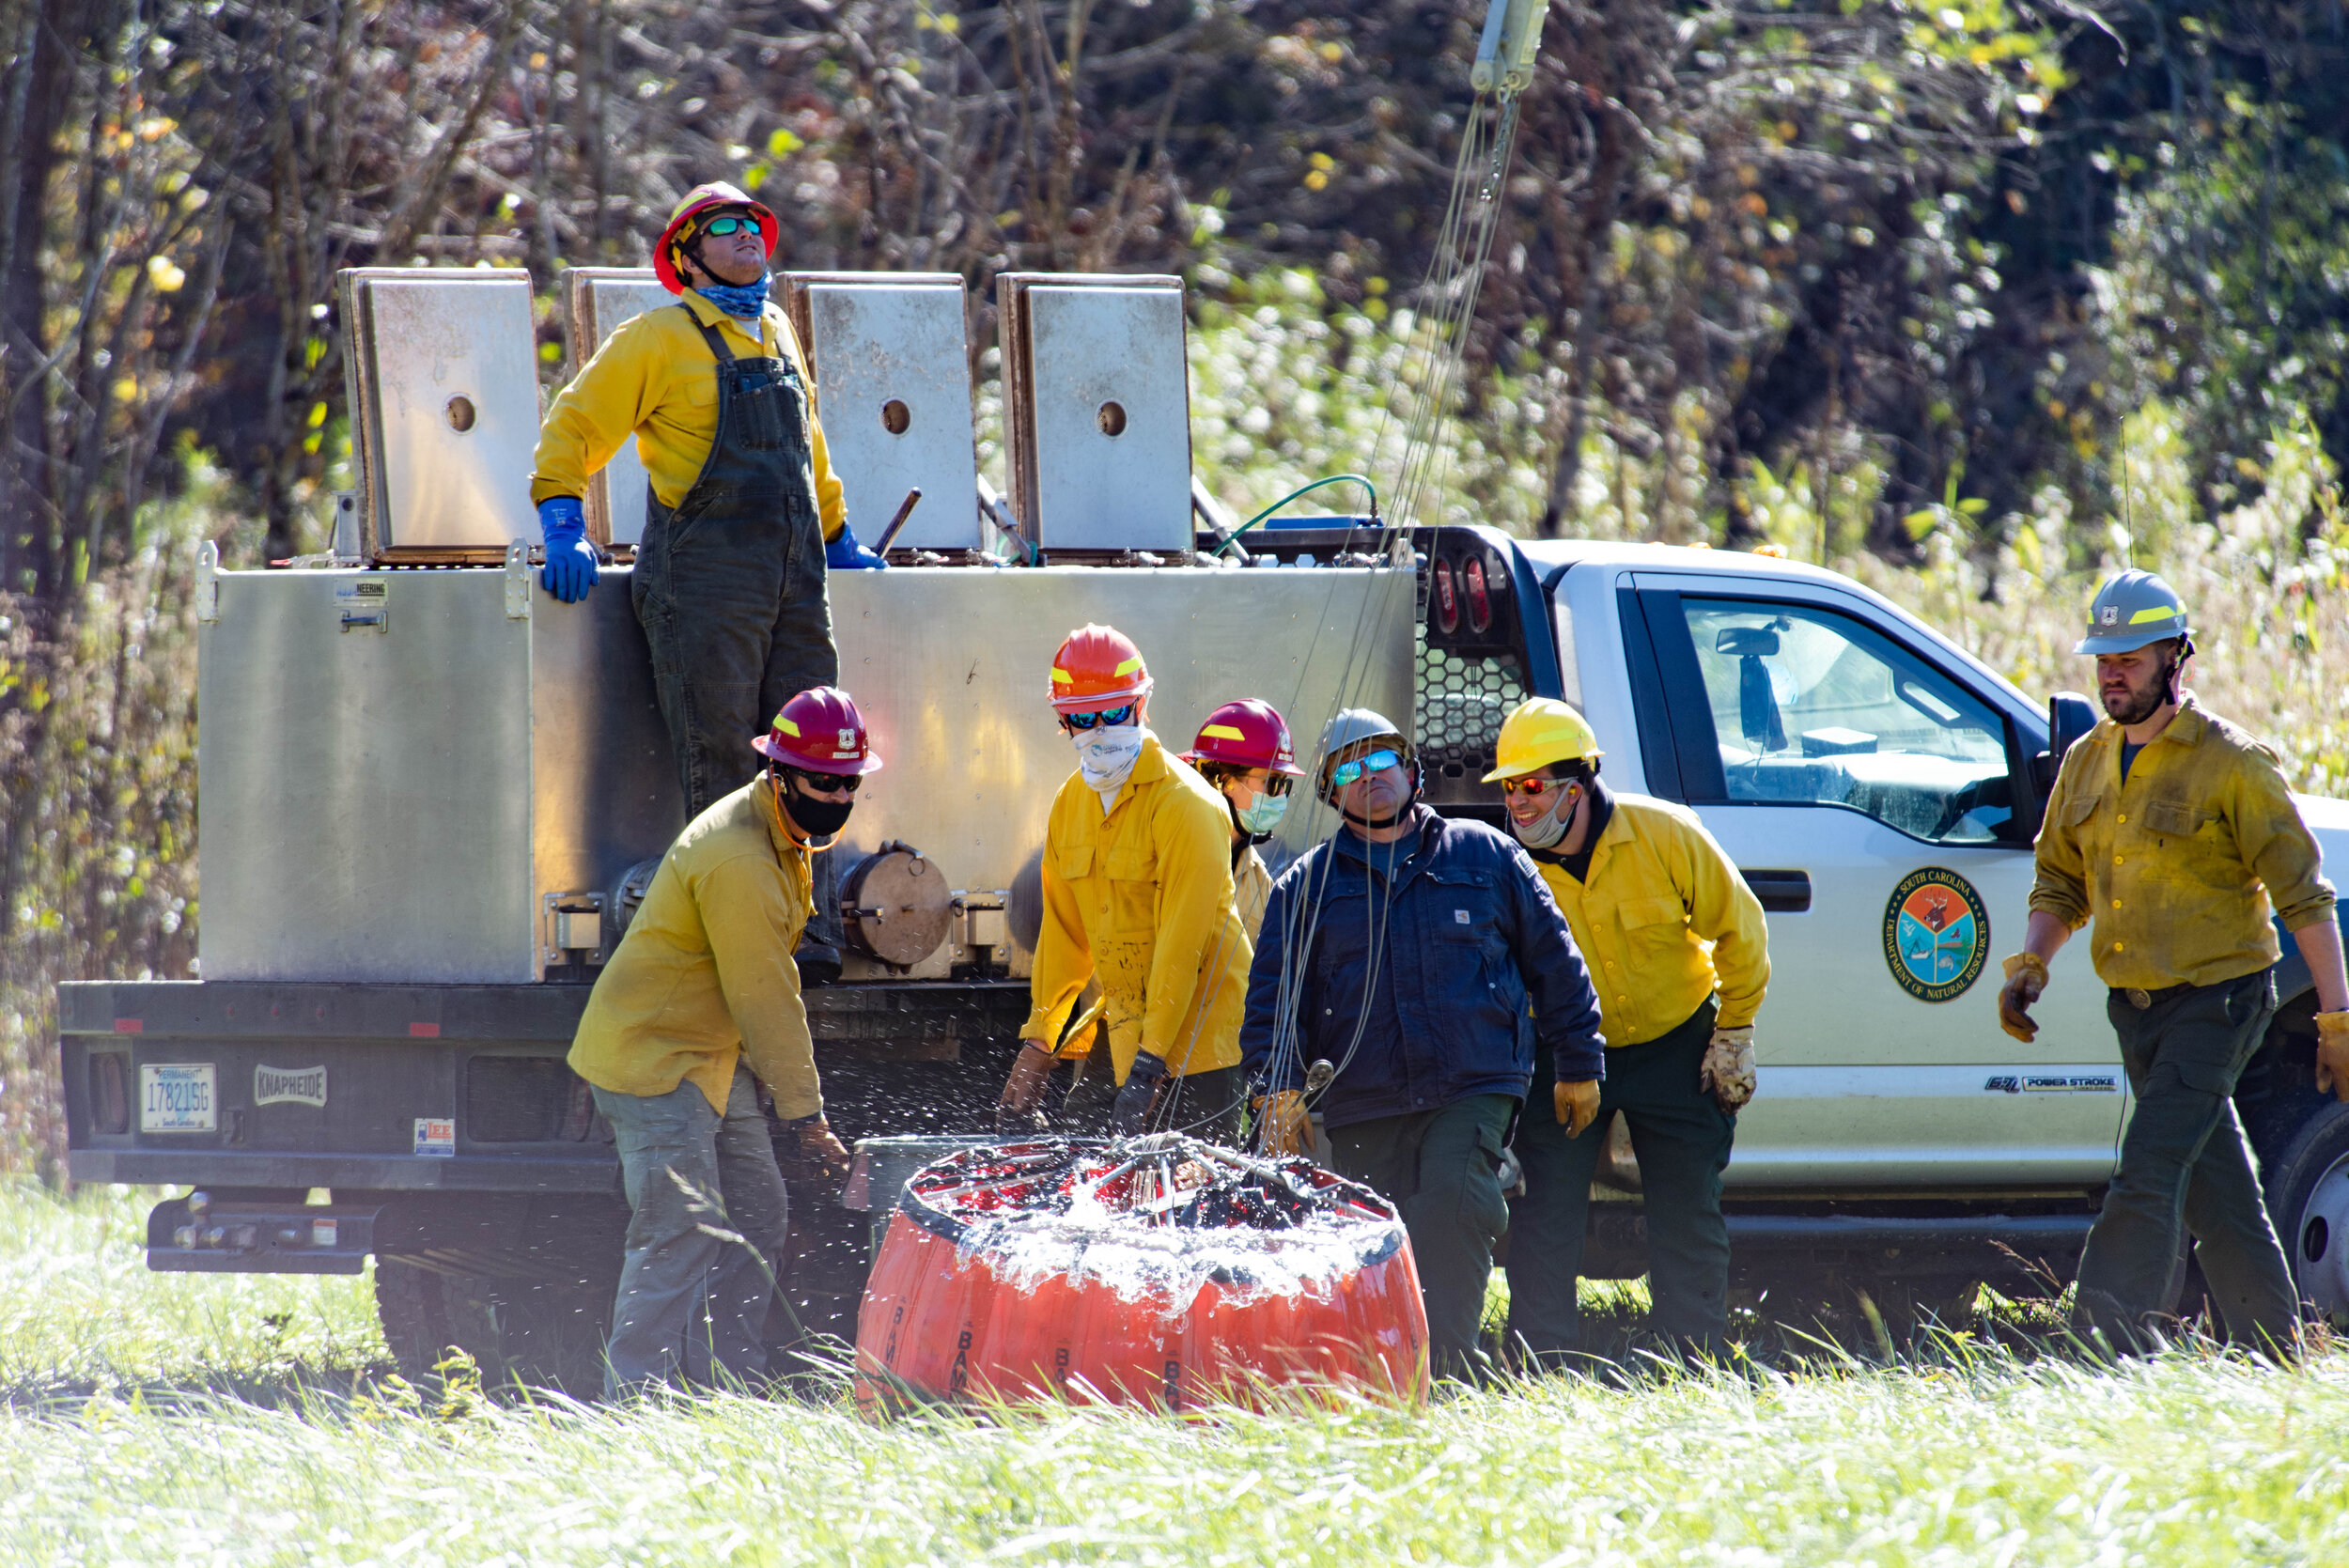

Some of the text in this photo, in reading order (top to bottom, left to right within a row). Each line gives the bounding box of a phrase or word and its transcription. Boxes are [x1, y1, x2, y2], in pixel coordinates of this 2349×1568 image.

[1900, 870, 1970, 896] SOUTH CAROLINA
[1886, 918, 1986, 1000] DEPARTMENT OF NATURAL RESOURCES
[159, 1069, 199, 1079] PERMANENT
[257, 1070, 323, 1100] KNAPHEIDE
[2028, 1078, 2115, 1086] POWER STROKE
[148, 1081, 209, 1112] 17821SG
[427, 1122, 452, 1139] LEE
[949, 1330, 972, 1389] BAM
